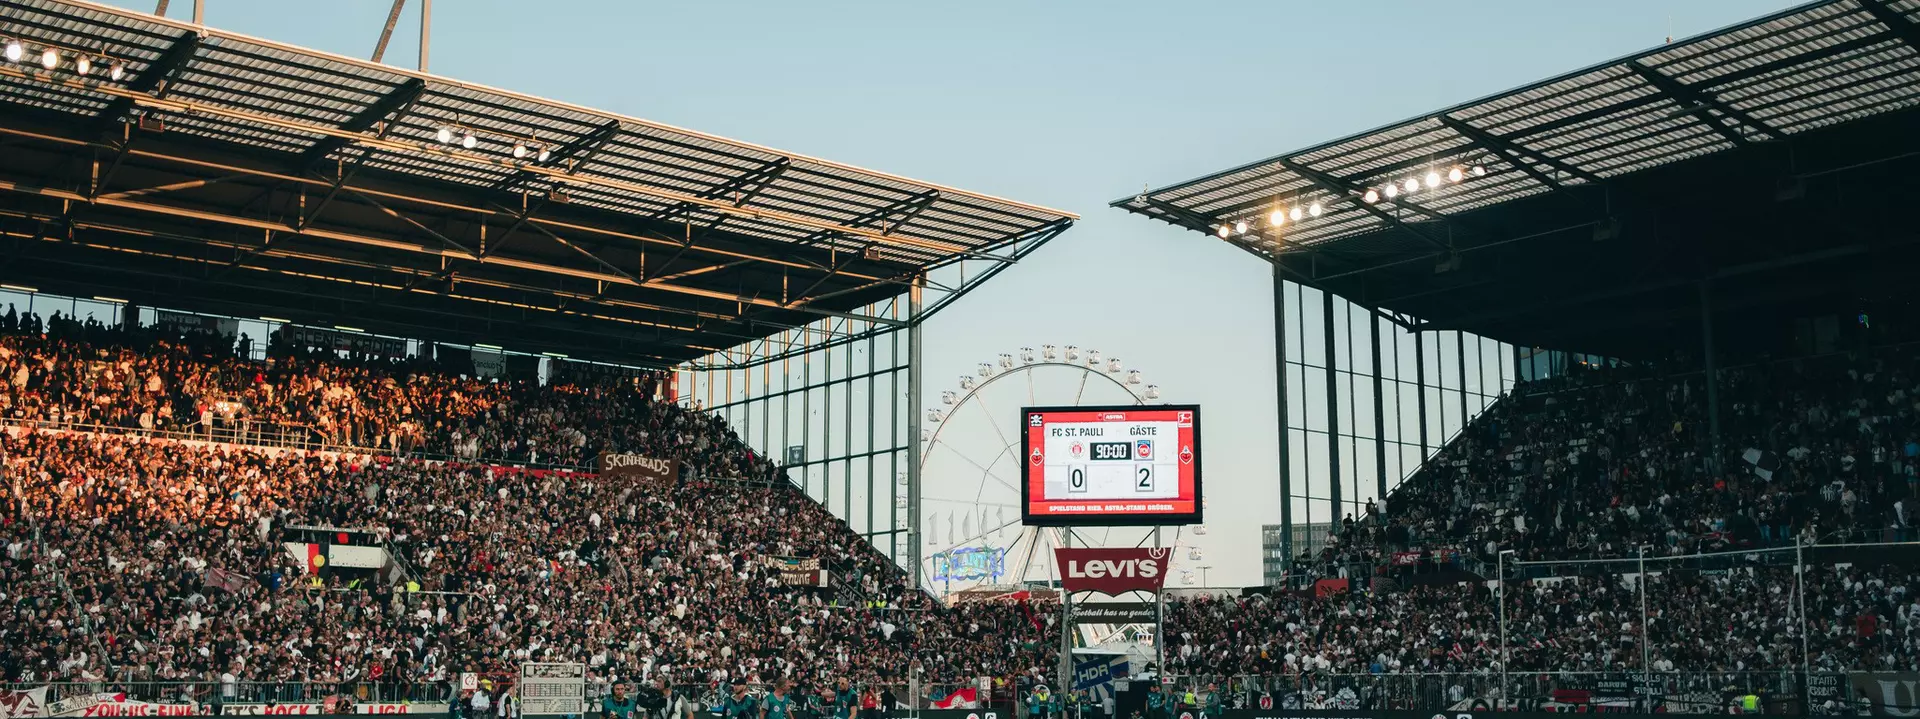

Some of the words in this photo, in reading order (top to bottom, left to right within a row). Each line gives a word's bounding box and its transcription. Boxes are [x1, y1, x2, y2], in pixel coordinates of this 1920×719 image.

[1052, 428, 1062, 437] FC
[1065, 428, 1077, 437] ST.
[1079, 428, 1104, 437] PAULI
[1130, 425, 1157, 436] GÄSTE
[1096, 444, 1127, 459] 90:00
[605, 453, 671, 476] SKINHEADS
[1072, 468, 1083, 488] 0
[1138, 468, 1150, 488] 2
[1071, 607, 1104, 617] Football
[1104, 608, 1117, 616] has
[1129, 608, 1155, 618] gender
[1079, 664, 1109, 683] HDR
[368, 705, 408, 715] LIGA
